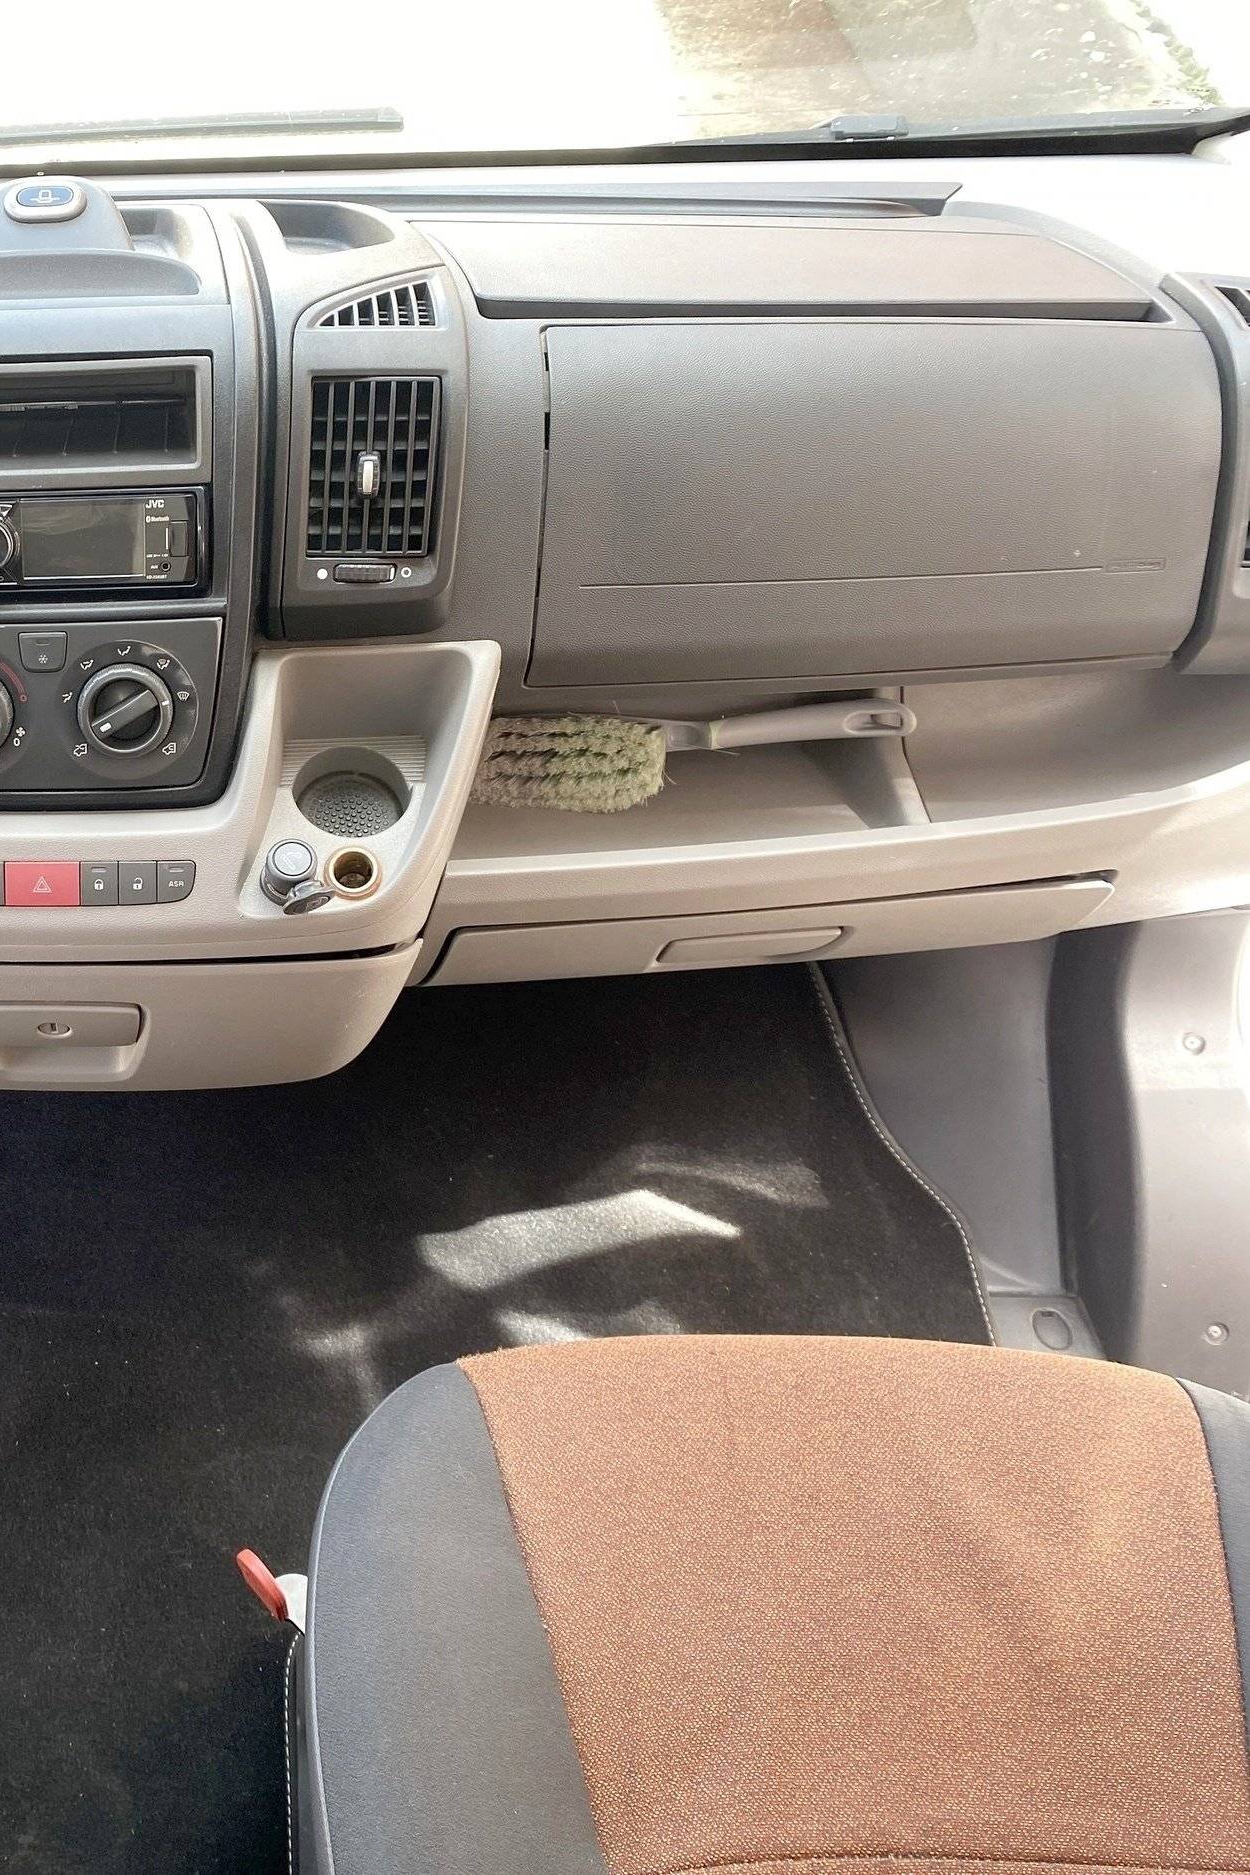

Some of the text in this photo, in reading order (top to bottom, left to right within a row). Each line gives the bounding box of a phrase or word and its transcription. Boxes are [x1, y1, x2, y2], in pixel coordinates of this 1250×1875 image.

[145, 499, 165, 509] JVC
[13, 738, 21, 747] 0
[168, 880, 185, 888] ASR
